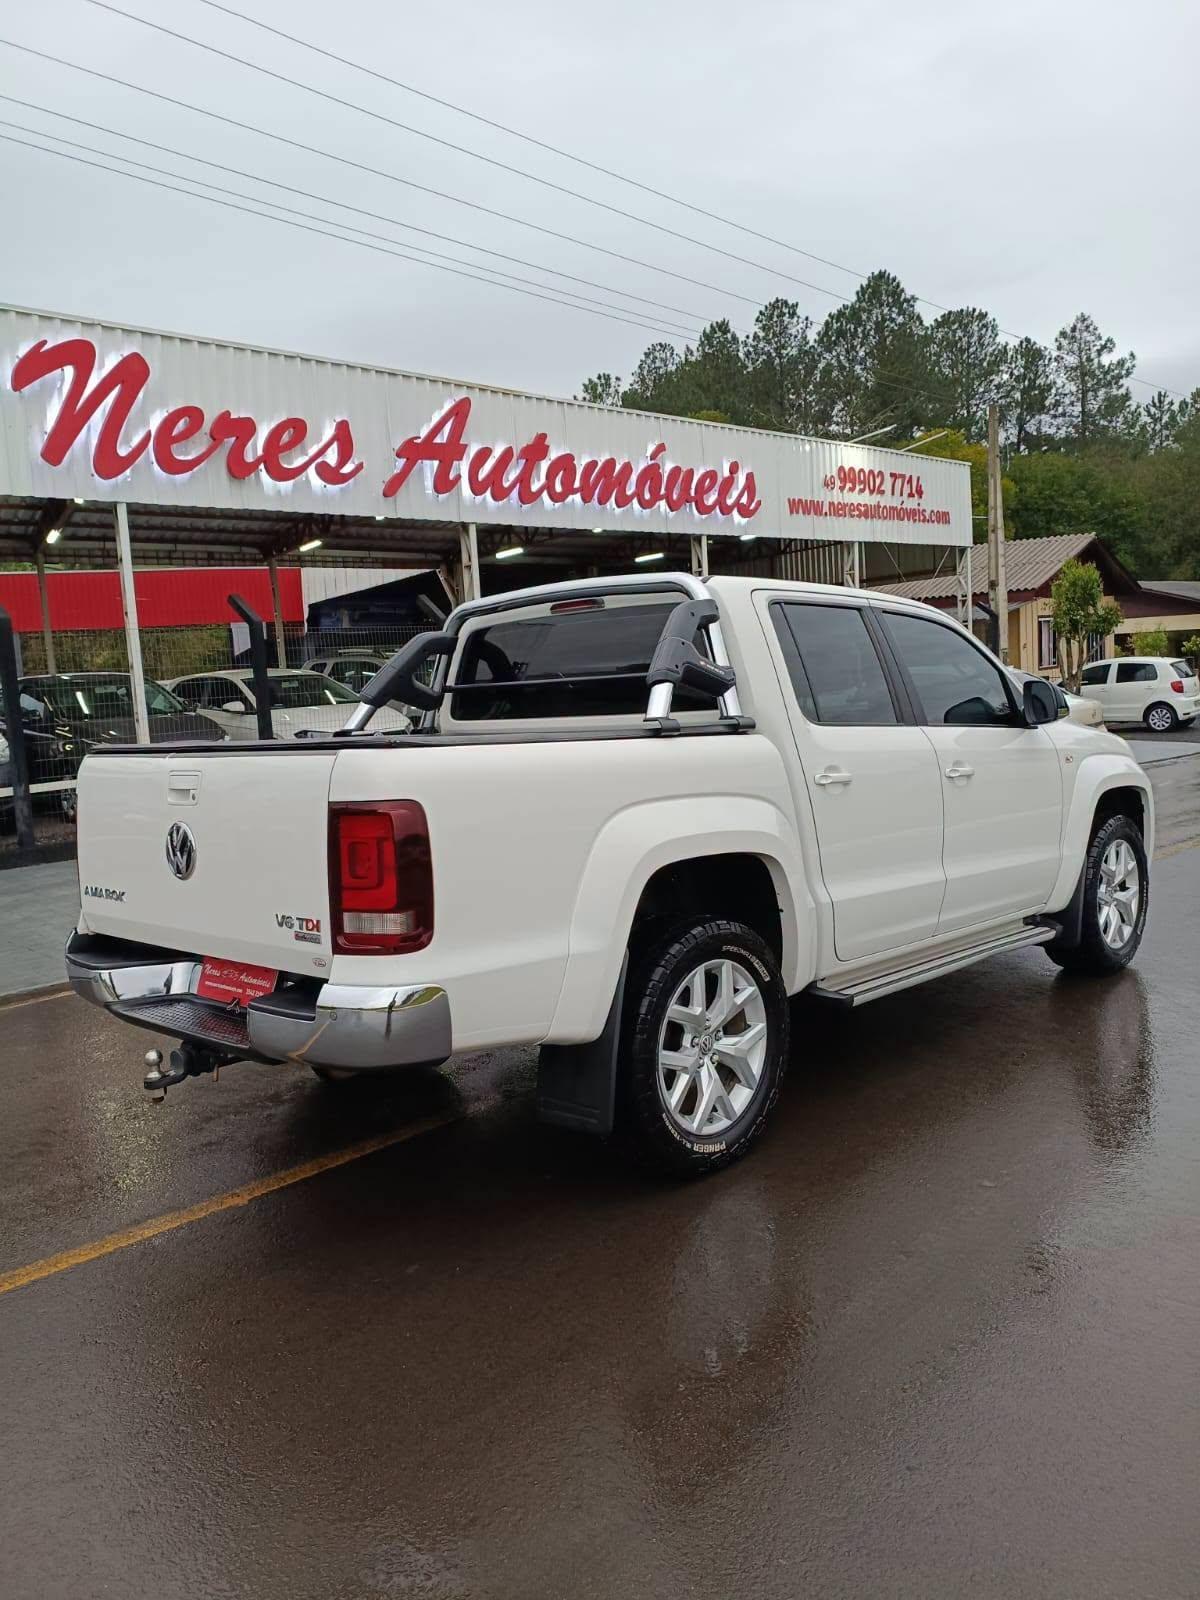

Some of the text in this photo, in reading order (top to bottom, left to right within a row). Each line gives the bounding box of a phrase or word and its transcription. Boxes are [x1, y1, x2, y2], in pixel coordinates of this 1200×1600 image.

[11, 338, 762, 522] Neres Automóveis
[823, 464, 924, 499] 49 99902 7714
[787, 497, 951, 525] www.neresautomóveis.com
[84, 885, 127, 902] AMAROK
[275, 913, 322, 933] V6 TDI
